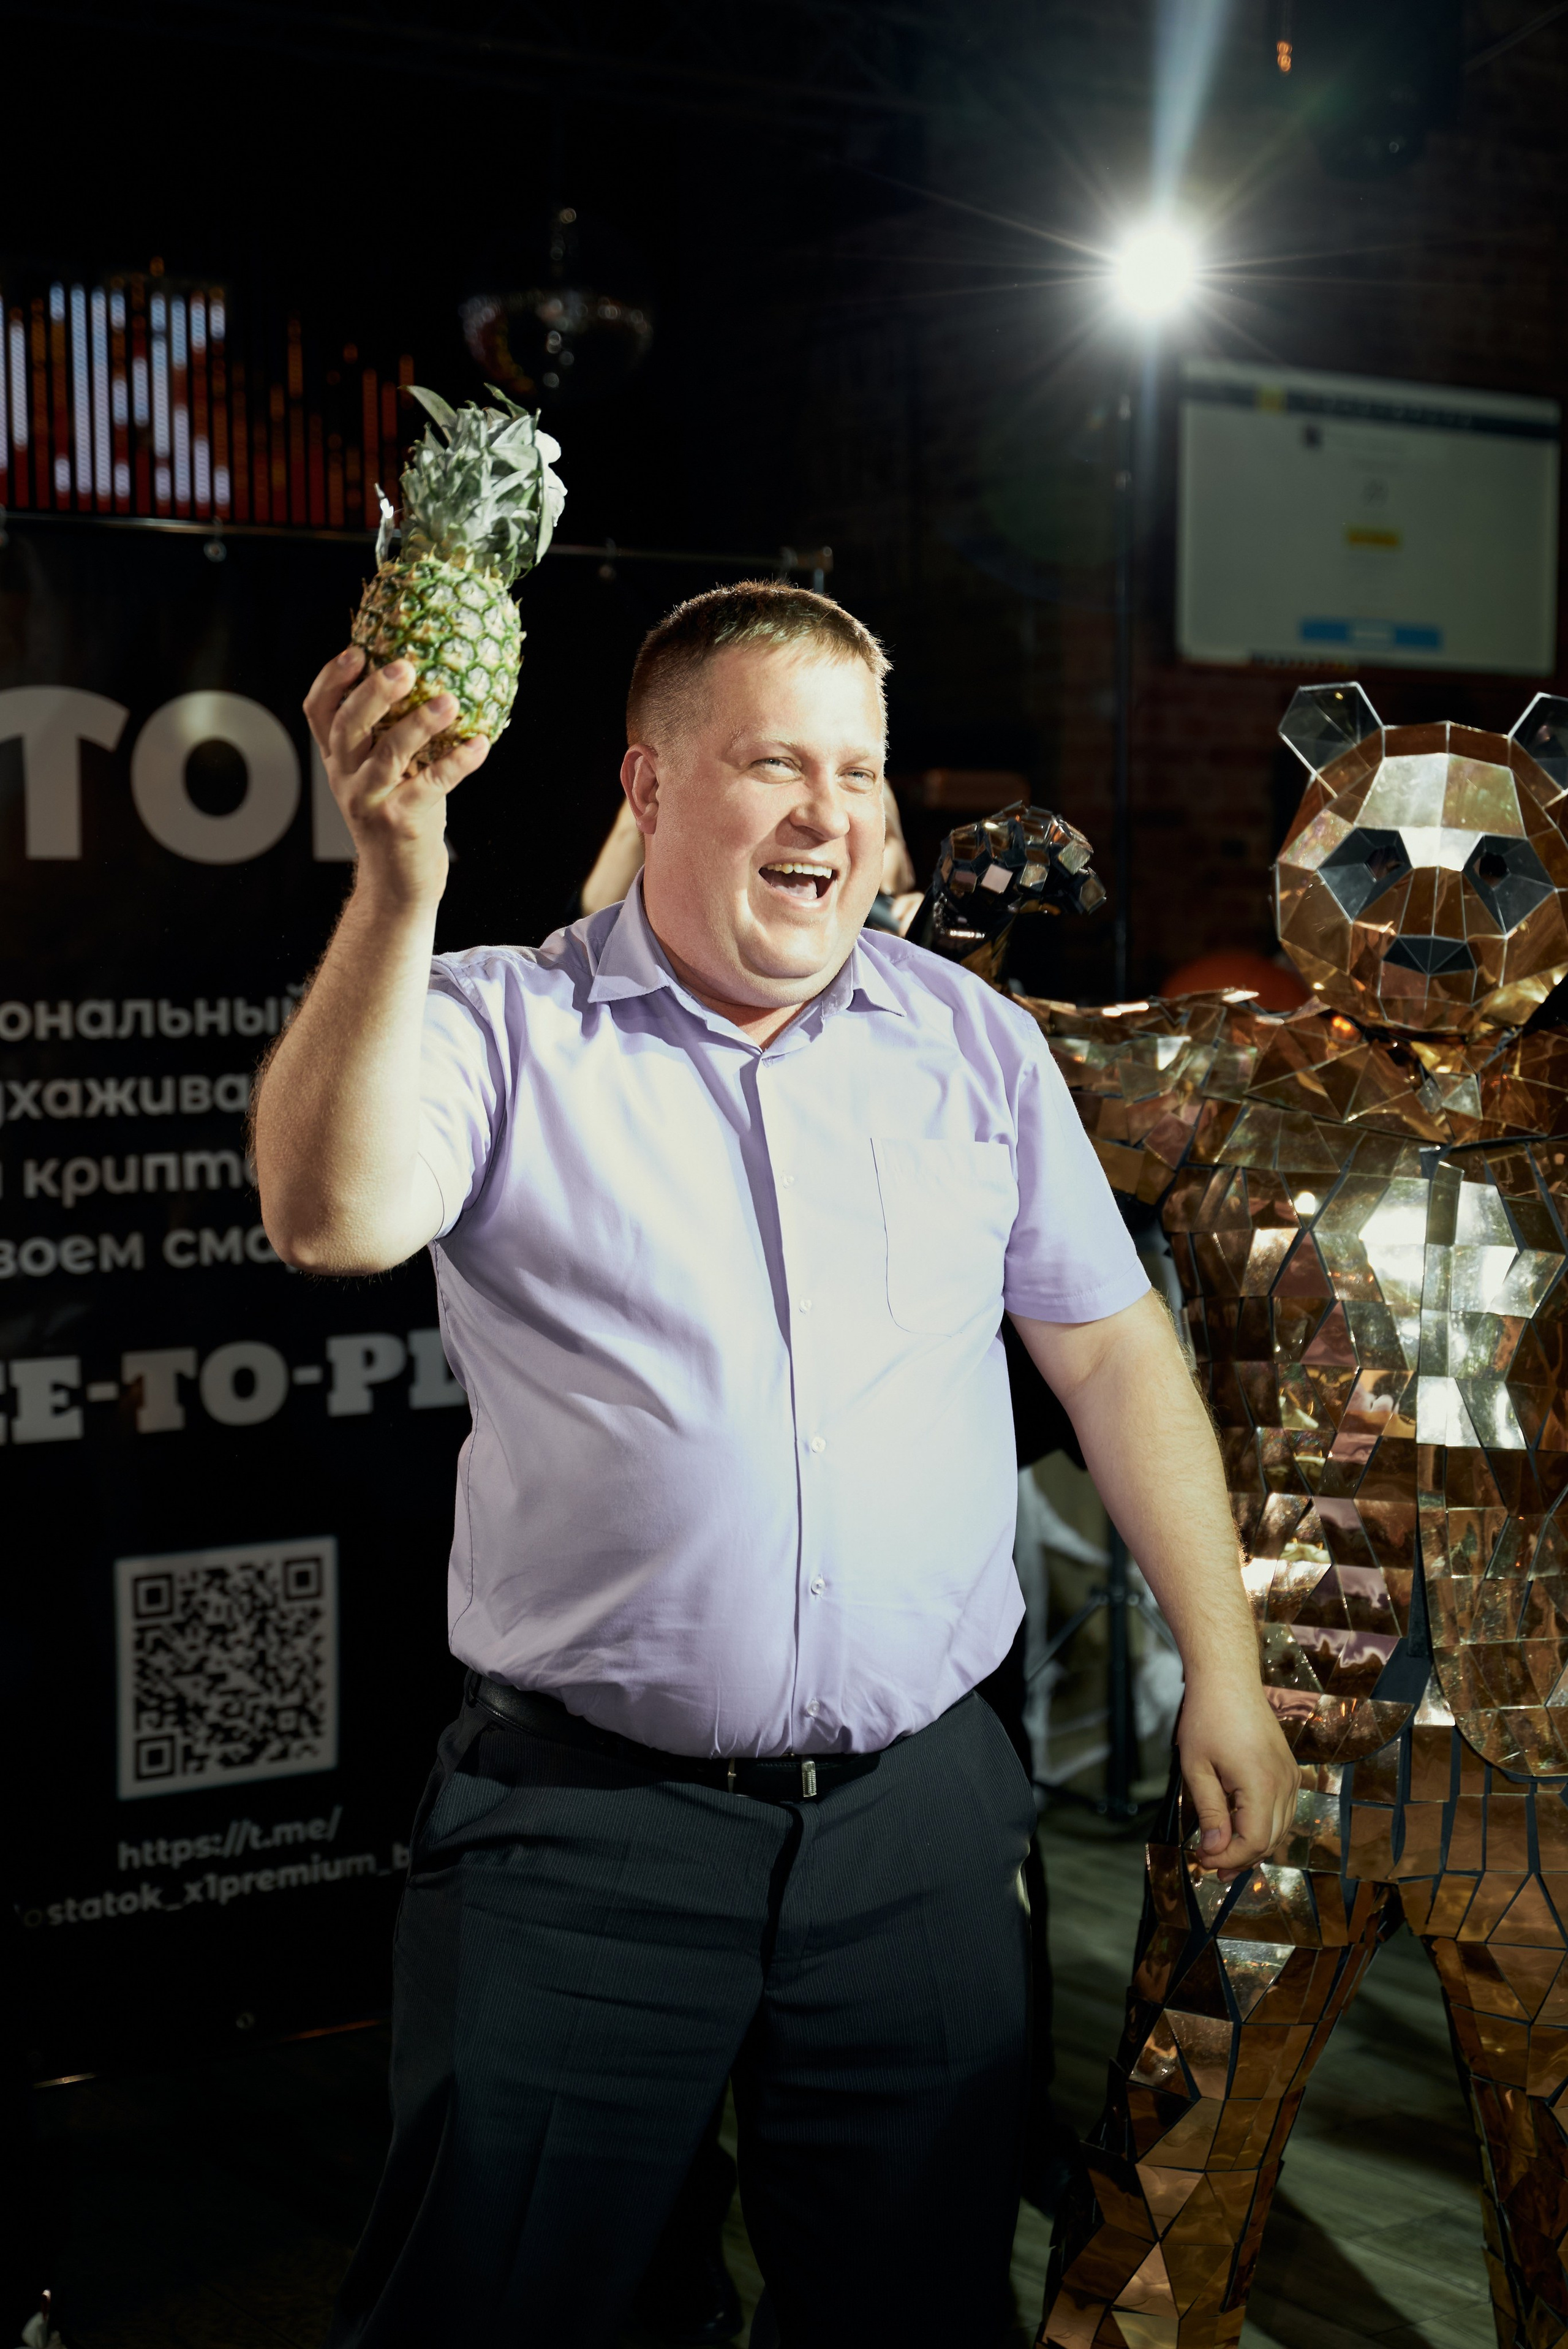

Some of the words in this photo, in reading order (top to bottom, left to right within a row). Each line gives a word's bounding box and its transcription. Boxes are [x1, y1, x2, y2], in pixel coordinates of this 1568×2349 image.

[162, 1225, 300, 1275] сма
[0, 1326, 468, 1447] E-TO-PL
[117, 1804, 344, 1872] https://t.me/
[13, 1840, 410, 1928] ostatok_x1premium_b
